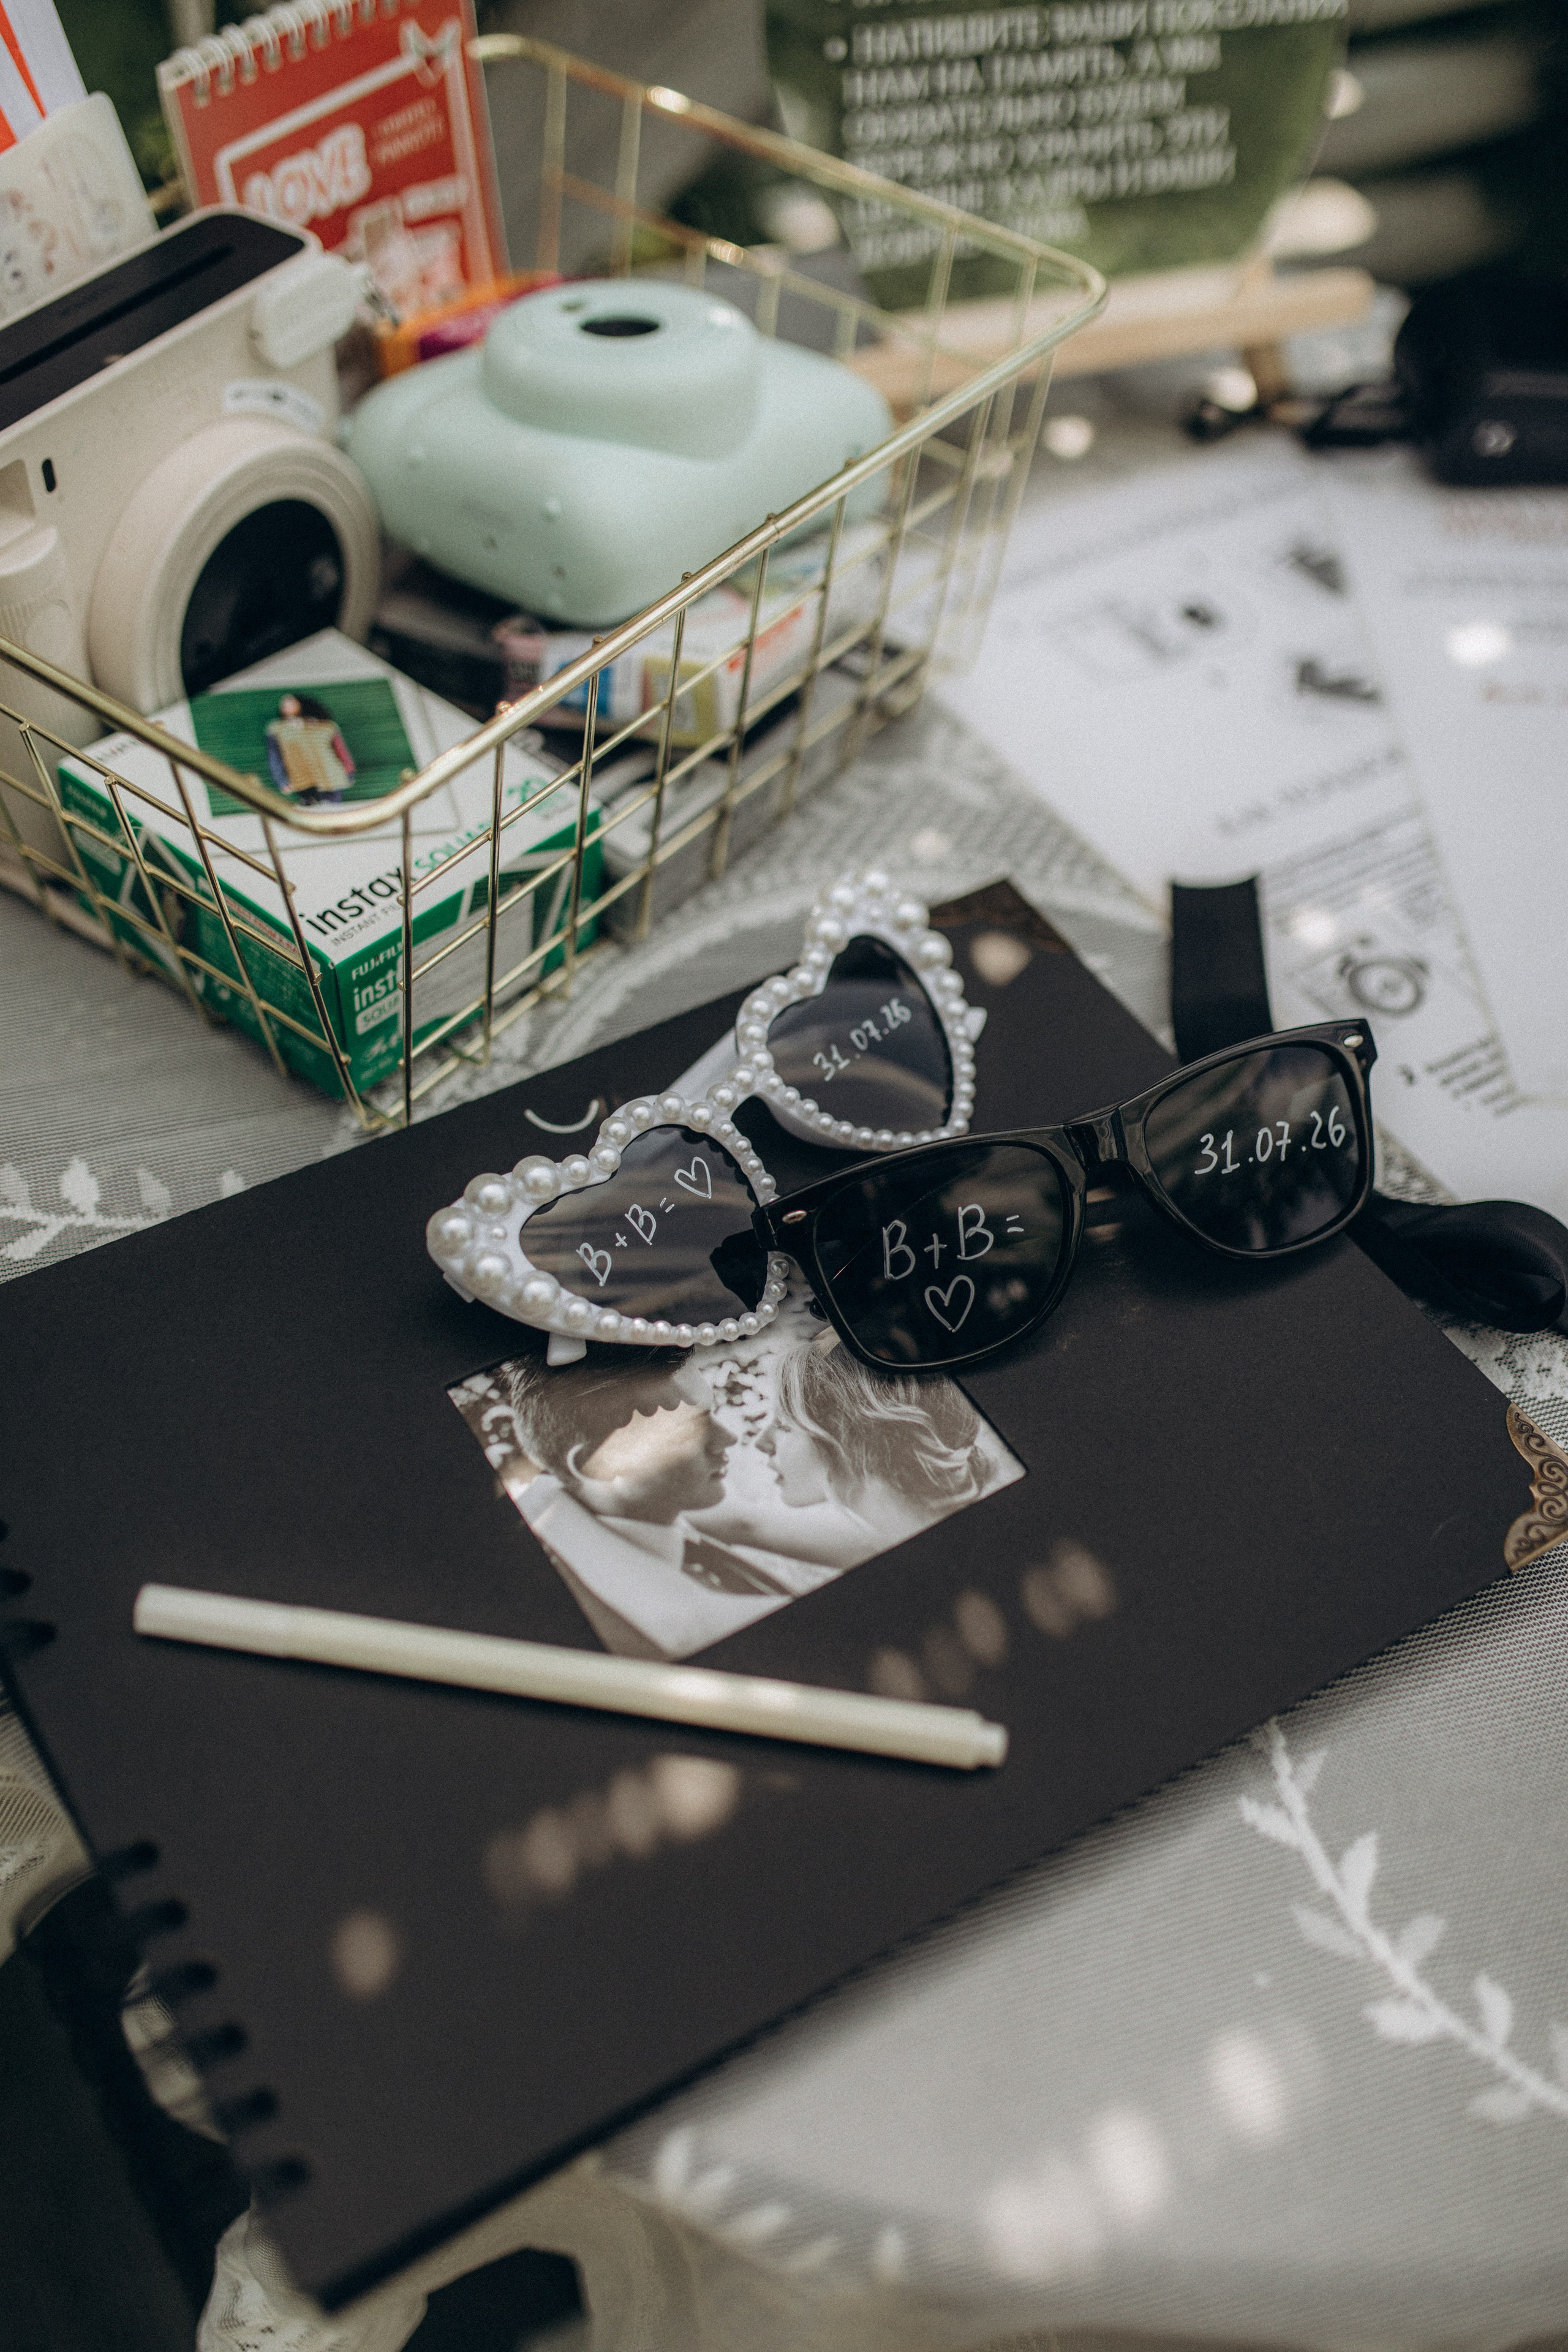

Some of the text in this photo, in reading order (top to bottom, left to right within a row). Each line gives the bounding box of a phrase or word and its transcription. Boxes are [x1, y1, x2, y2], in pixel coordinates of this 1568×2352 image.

[299, 867, 417, 935] instax
[353, 969, 397, 1012] inst
[813, 997, 912, 1082] 31.07.26
[1194, 1105, 1346, 1174] 31.07.26
